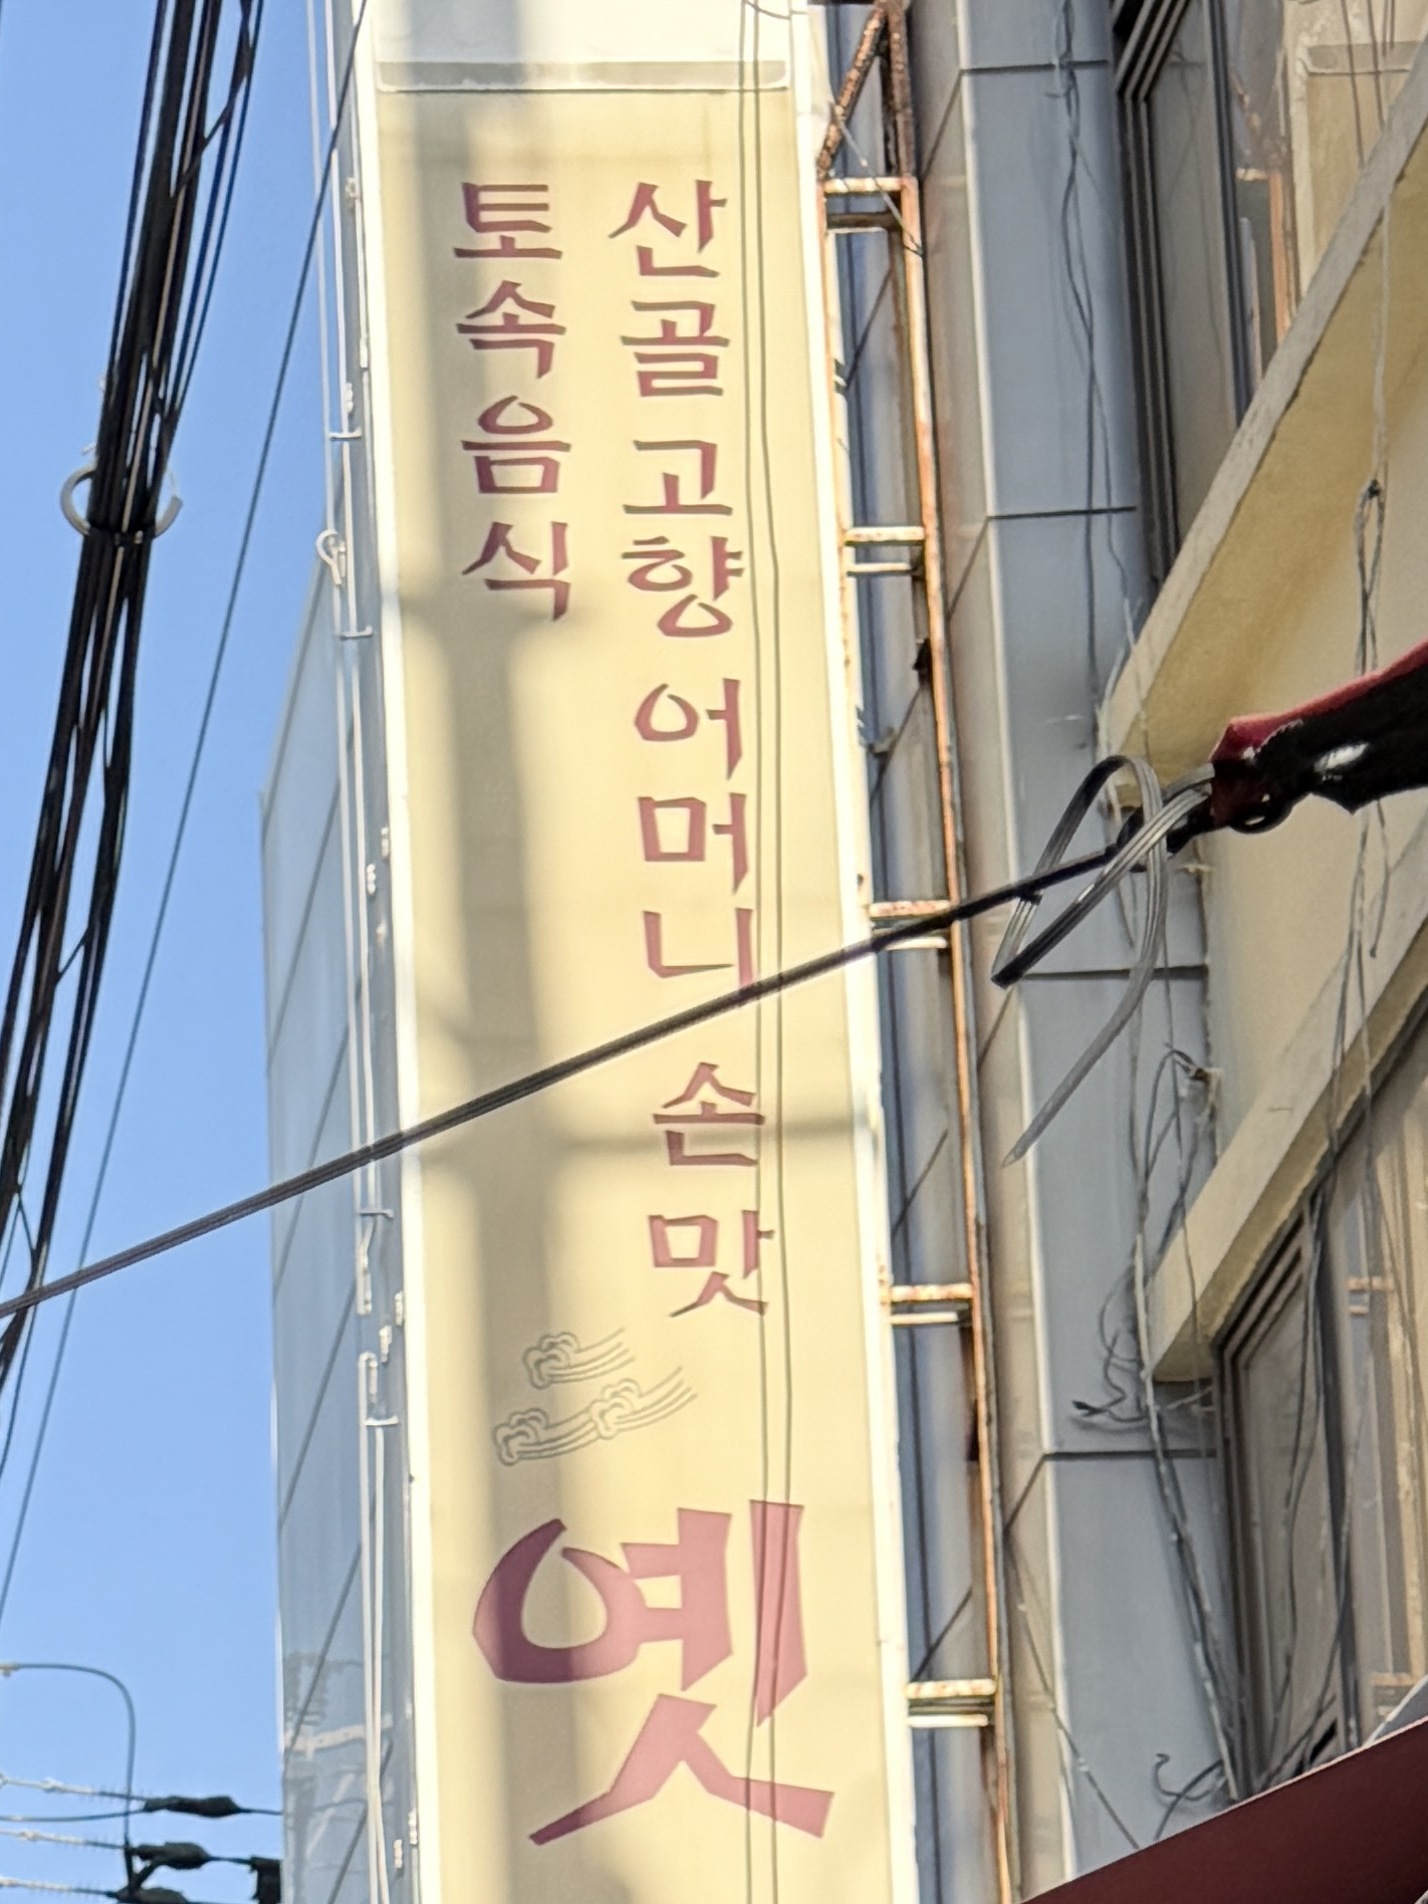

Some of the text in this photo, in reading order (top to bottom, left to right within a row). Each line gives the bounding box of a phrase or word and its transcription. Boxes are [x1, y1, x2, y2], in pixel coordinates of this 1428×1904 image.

[451, 182, 574, 622] 토속음식
[608, 180, 774, 1317] 산골 고향 어머니 손맛
